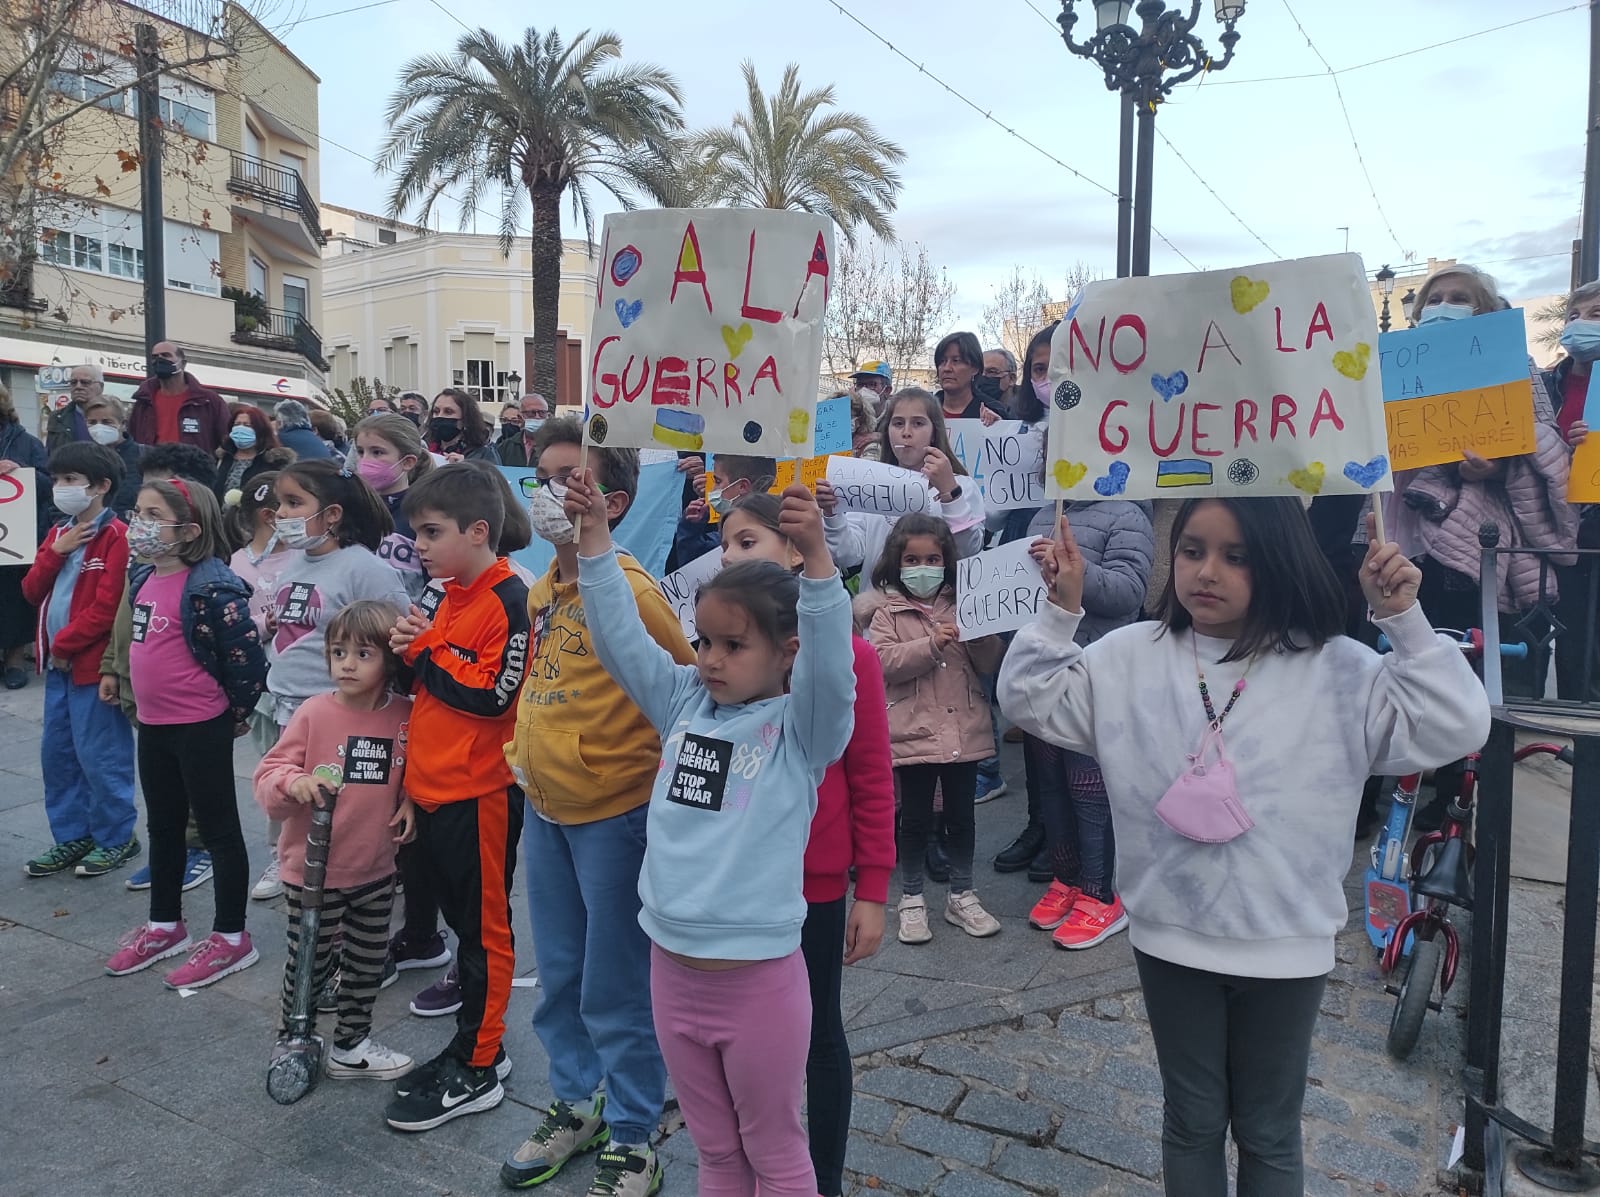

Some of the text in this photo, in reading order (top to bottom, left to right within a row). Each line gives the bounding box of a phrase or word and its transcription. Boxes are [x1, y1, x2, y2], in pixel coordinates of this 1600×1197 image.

[670, 219, 713, 315] A
[741, 228, 830, 324] LA
[1069, 302, 1334, 375] NO A LA
[1469, 335, 1482, 356] A
[592, 336, 784, 409] GUERRA
[1401, 376, 1425, 396] LA
[1099, 387, 1345, 457] GUERRA
[985, 436, 1021, 466] NO
[960, 556, 1030, 594] NO A LA
[659, 571, 691, 605] NO
[959, 586, 1048, 630] GUERRA
[352, 748, 387, 759] GUERRA
[357, 740, 370, 749] NO
[684, 740, 716, 759] NO A LA
[356, 761, 379, 771] STOP
[678, 752, 720, 773] GUERRA
[364, 771, 384, 780] WAR
[677, 772, 706, 789] STOP
[683, 787, 712, 805] WAR
